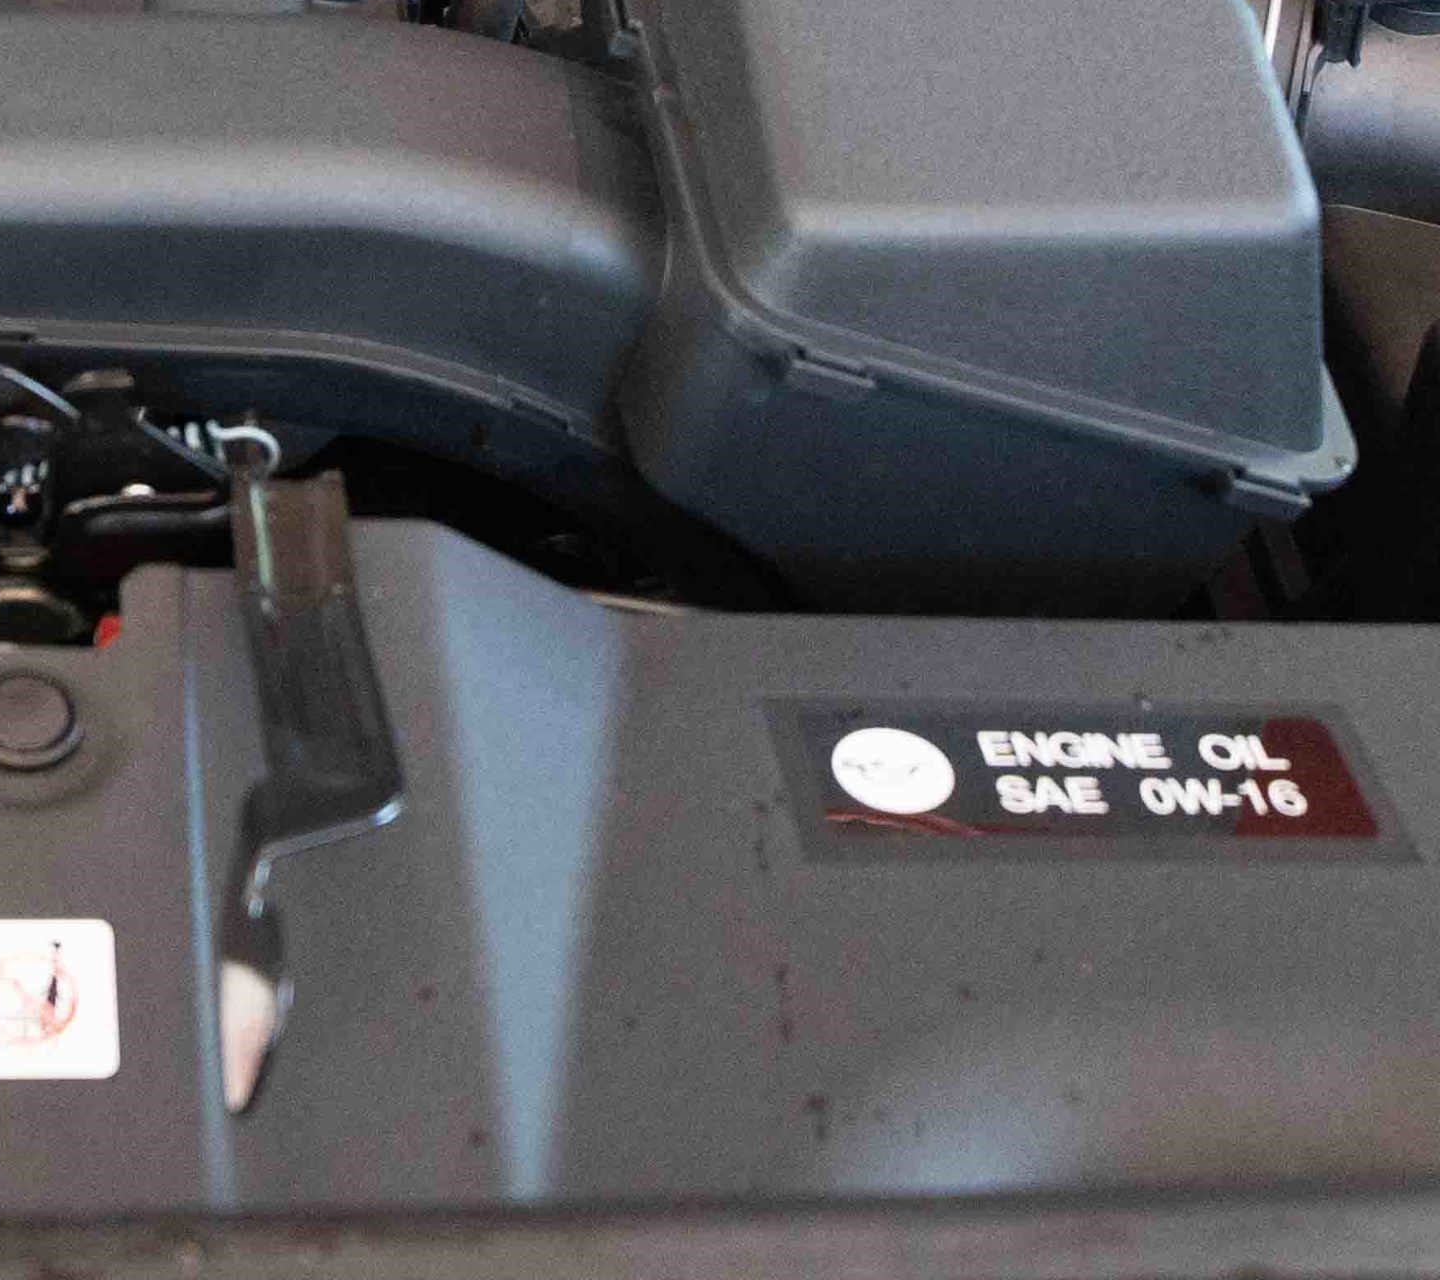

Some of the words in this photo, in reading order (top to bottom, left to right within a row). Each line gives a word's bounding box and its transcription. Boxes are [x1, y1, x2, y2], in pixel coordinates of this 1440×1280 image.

[976, 730, 1173, 770] ENGINE
[1198, 733, 1292, 772] OIL
[995, 775, 1110, 815] SAE
[1138, 777, 1308, 817] 0W-16
